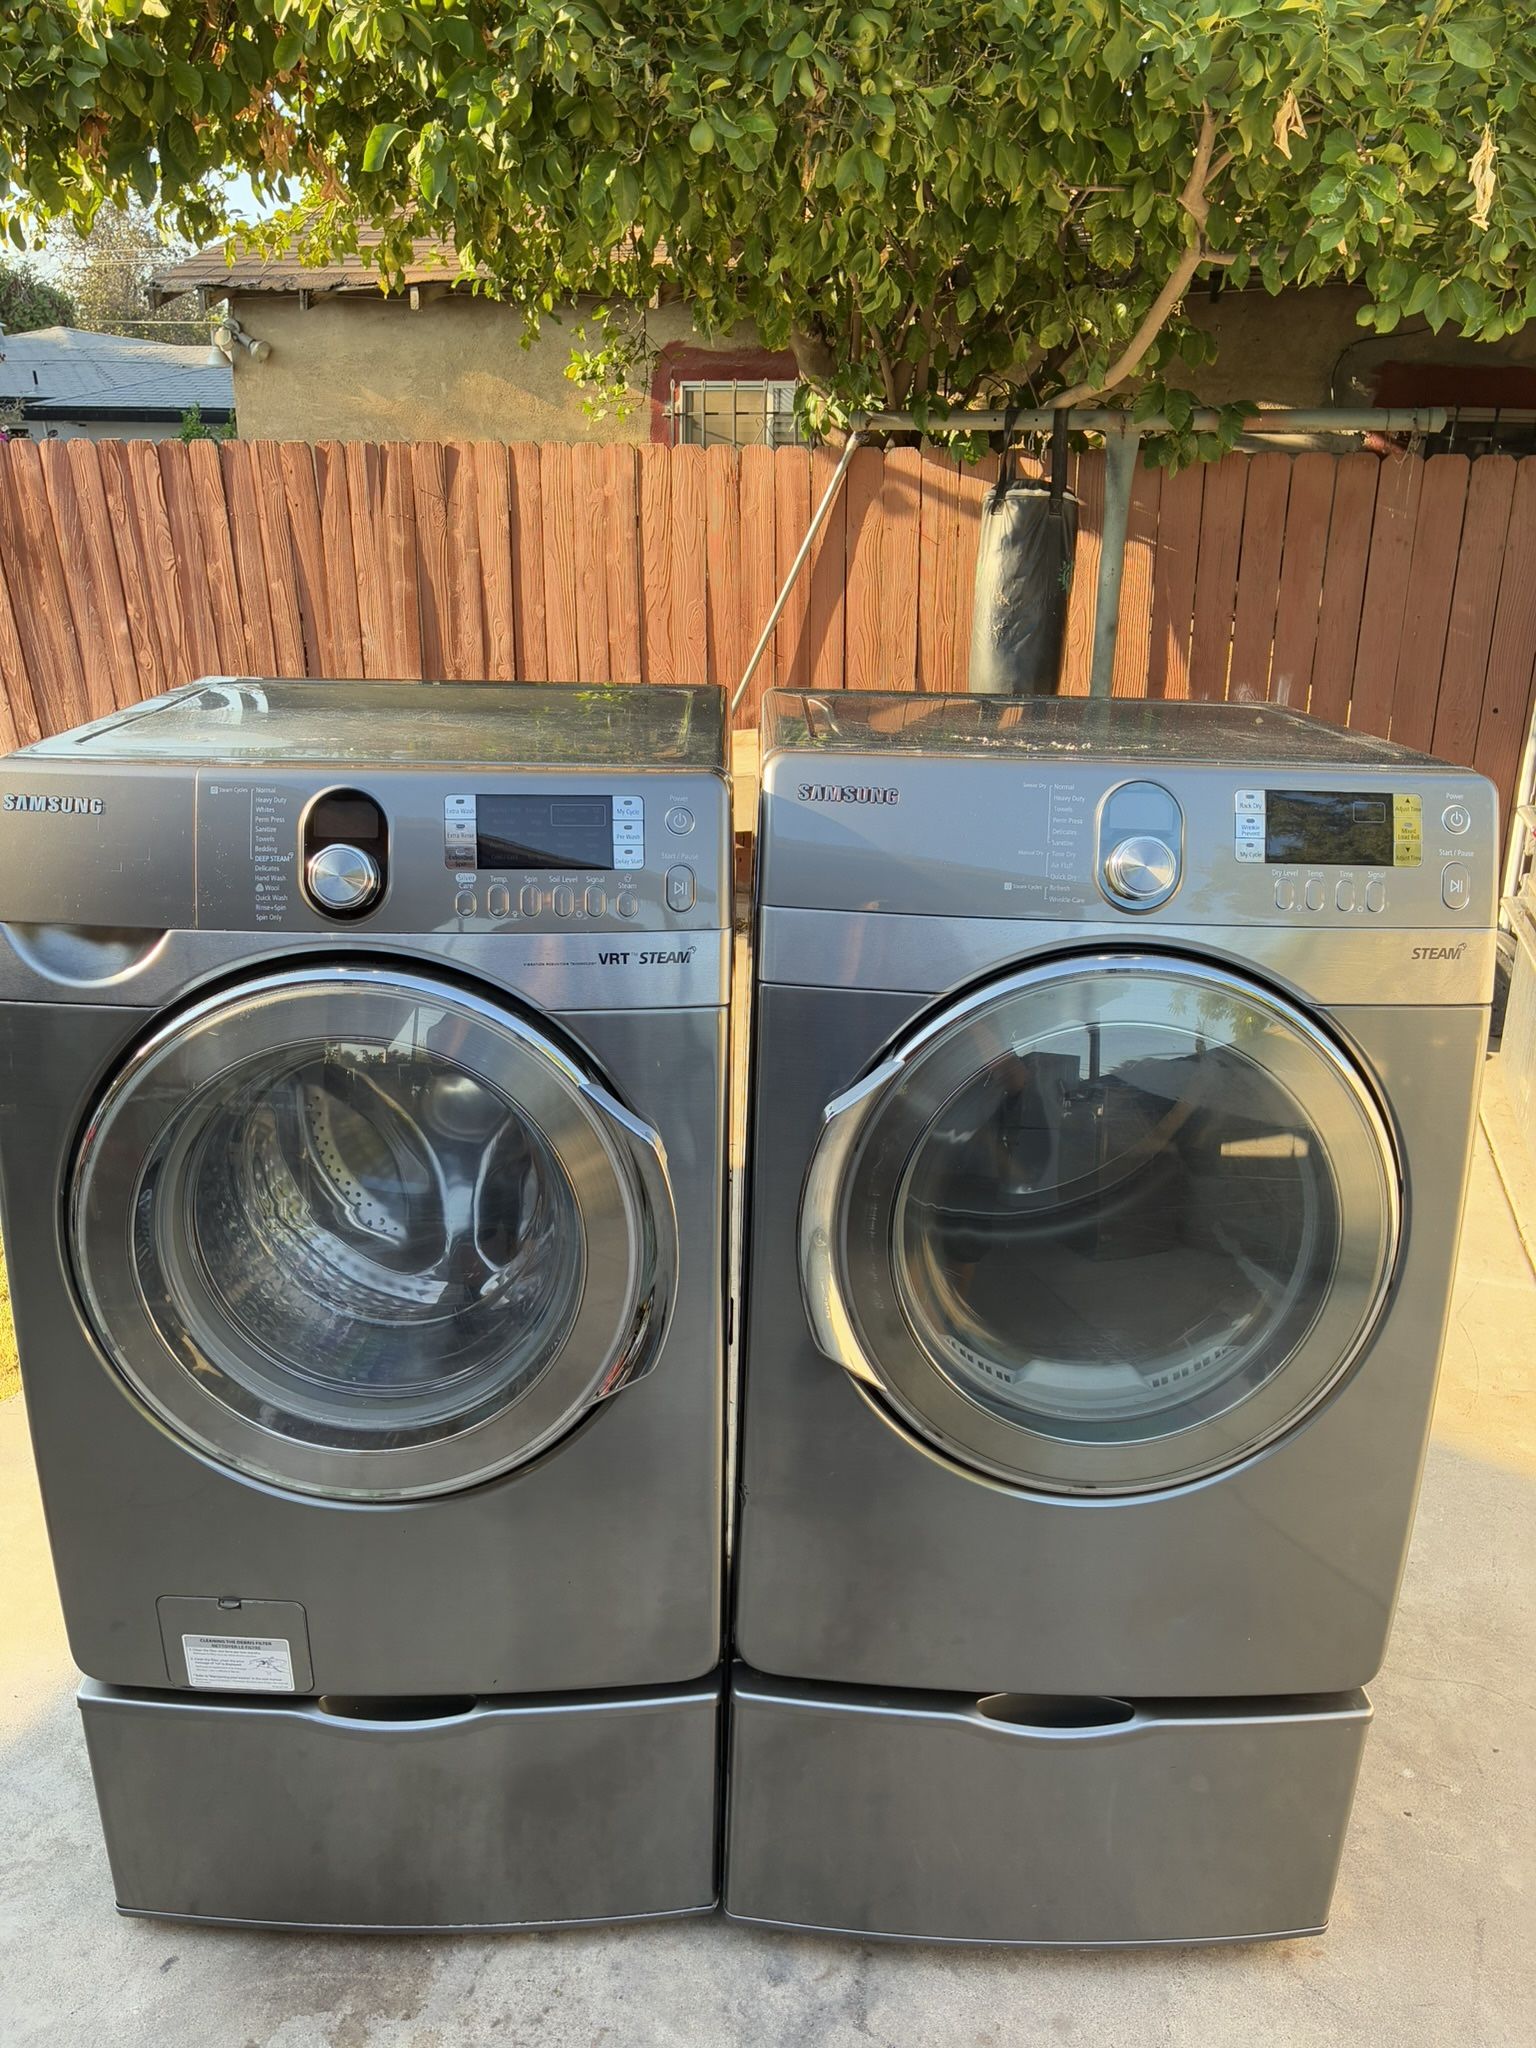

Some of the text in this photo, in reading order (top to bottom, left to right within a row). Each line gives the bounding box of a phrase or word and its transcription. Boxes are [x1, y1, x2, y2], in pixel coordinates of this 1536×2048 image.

[798, 783, 899, 805] SAMSUNG
[1445, 792, 1464, 800] Power
[1072, 795, 1085, 803] Duty
[3, 793, 103, 815] SAMSUNG
[255, 845, 278, 854] Bedding
[1457, 849, 1474, 857] Pause
[1272, 869, 1299, 878] Dry Level
[1340, 870, 1353, 878] Time
[1367, 871, 1386, 880] Signal
[524, 875, 538, 883] Spin
[549, 875, 578, 883] Soil Level
[586, 875, 605, 884] Signal
[256, 914, 282, 922] Spin Only
[639, 951, 691, 965] STEAM
[1411, 948, 1462, 960] STEAM
